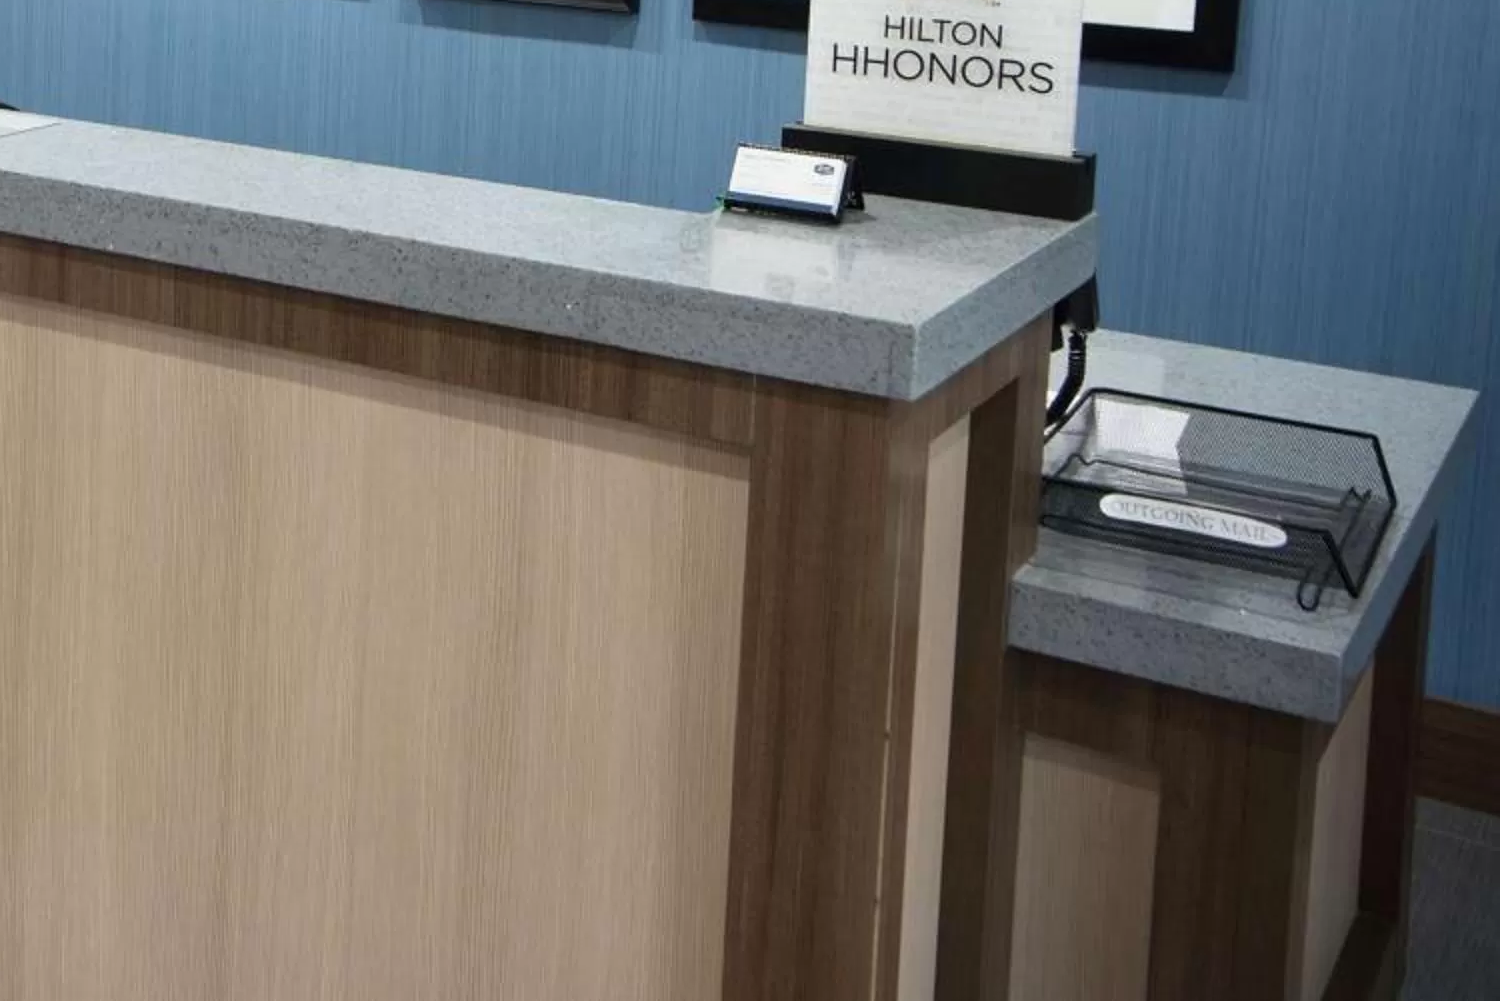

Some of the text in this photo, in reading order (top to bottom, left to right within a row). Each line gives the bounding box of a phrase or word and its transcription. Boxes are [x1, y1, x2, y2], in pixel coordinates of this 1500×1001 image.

[883, 14, 1003, 49] HILTON
[832, 43, 1055, 94] HHONORS
[1111, 500, 1271, 542] OUTGOING MAIL
